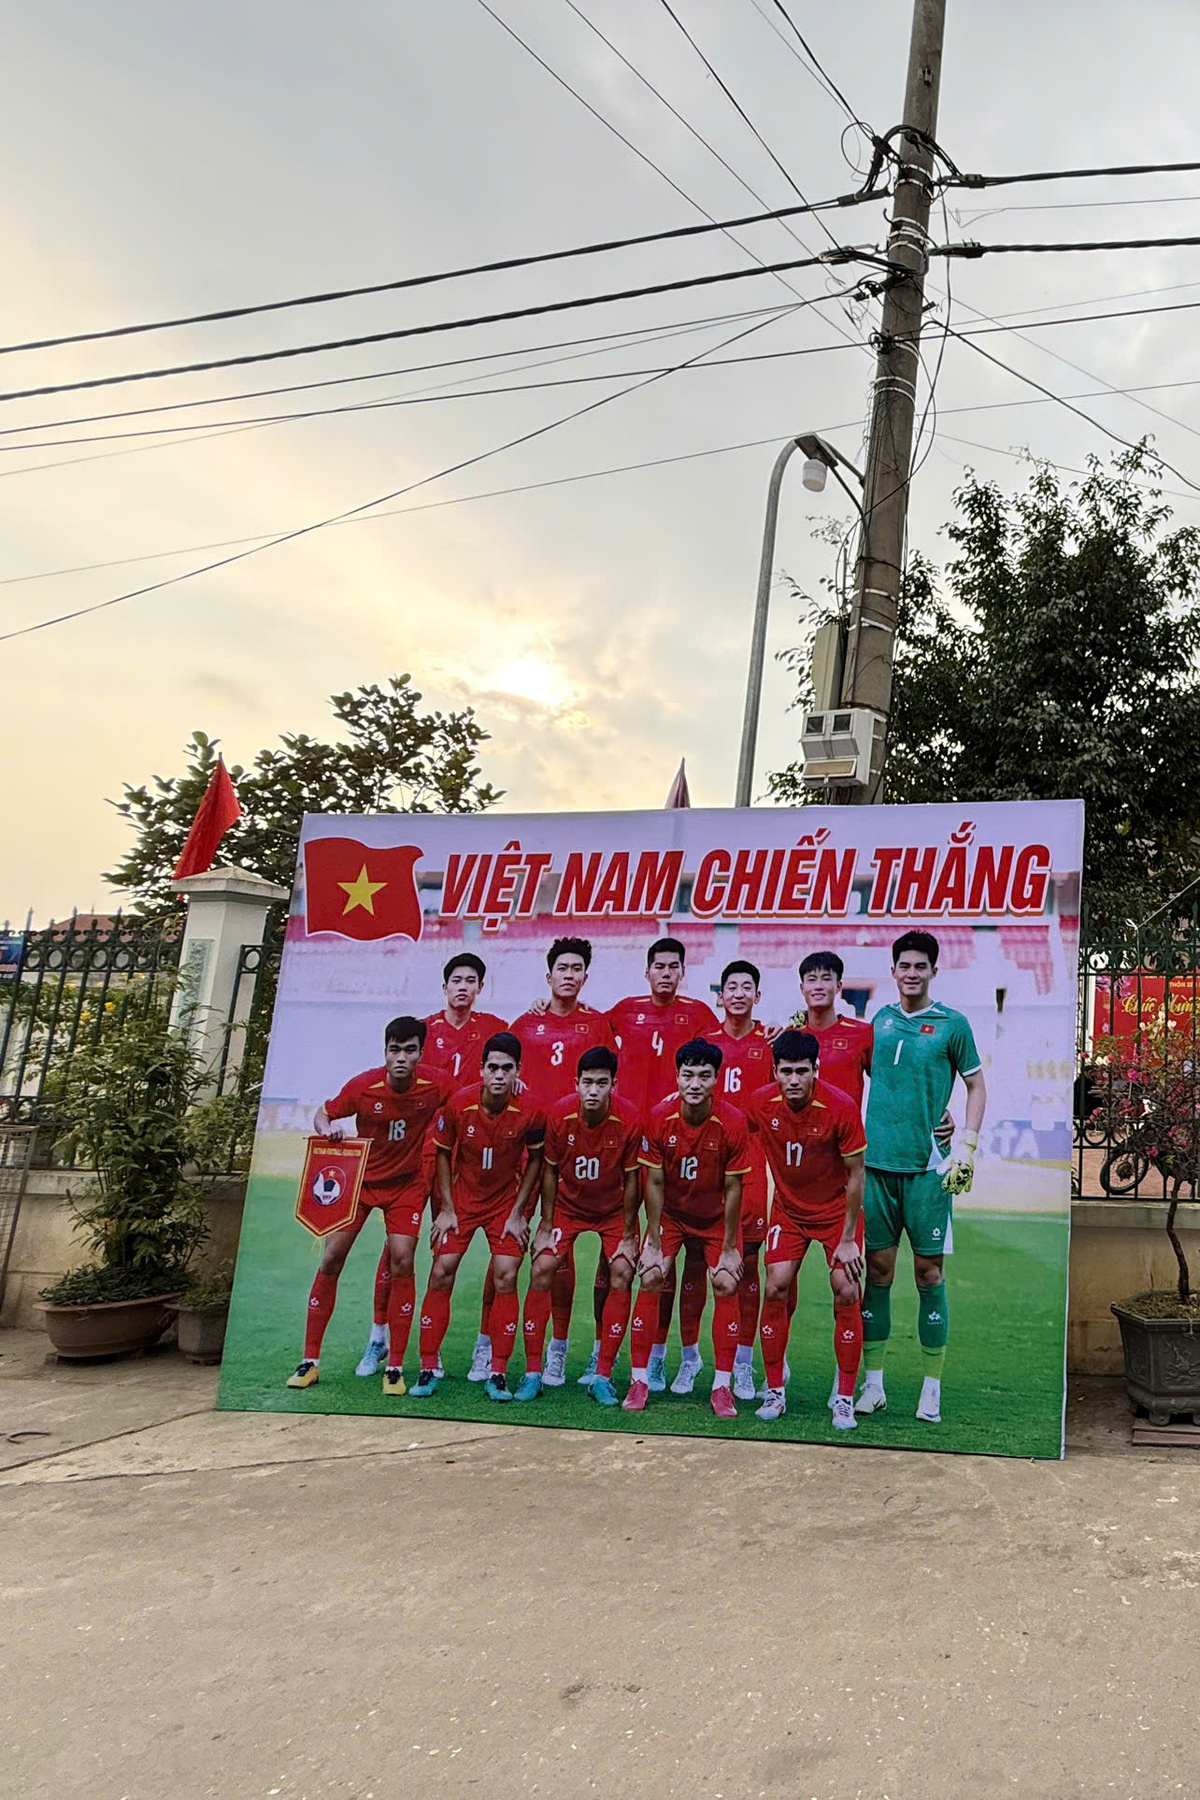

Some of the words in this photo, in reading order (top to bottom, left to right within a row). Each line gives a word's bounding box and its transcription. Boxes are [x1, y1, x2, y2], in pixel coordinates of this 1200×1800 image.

[440, 840, 552, 933] VIỆT
[553, 850, 685, 919] NAM
[690, 828, 858, 919] CHIẾN
[867, 821, 1053, 918] THẮNG
[551, 1042, 565, 1066] 3
[651, 1030, 664, 1056] 4
[723, 1066, 742, 1093] 16
[388, 1120, 406, 1142] 18
[482, 1147, 493, 1170] 11
[785, 1141, 804, 1167] 17
[575, 1156, 600, 1180] 20
[680, 1156, 698, 1181] 12
